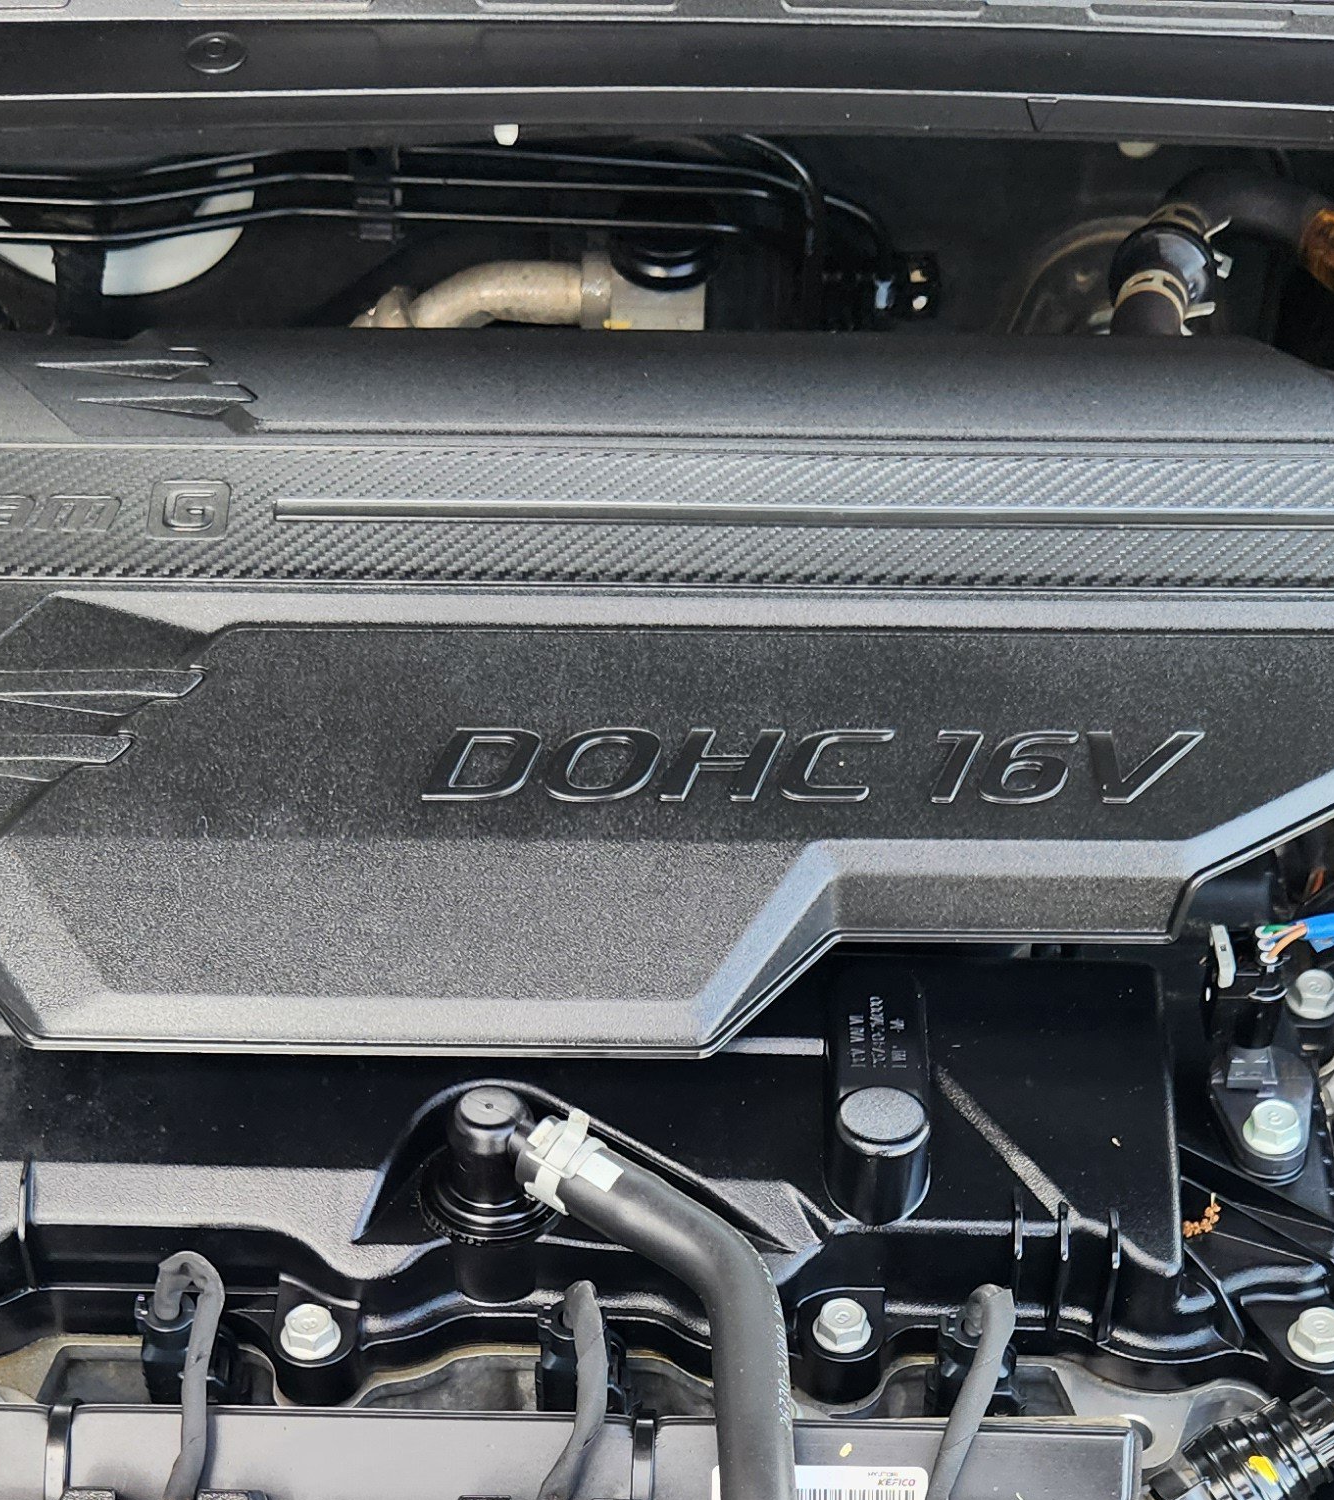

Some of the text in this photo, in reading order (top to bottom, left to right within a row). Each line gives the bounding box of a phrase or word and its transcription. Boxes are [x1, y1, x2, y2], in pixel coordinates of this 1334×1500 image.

[164, 486, 223, 534] G
[421, 727, 1207, 803] DOHC 16V
[877, 1479, 916, 1487] KEFICO
